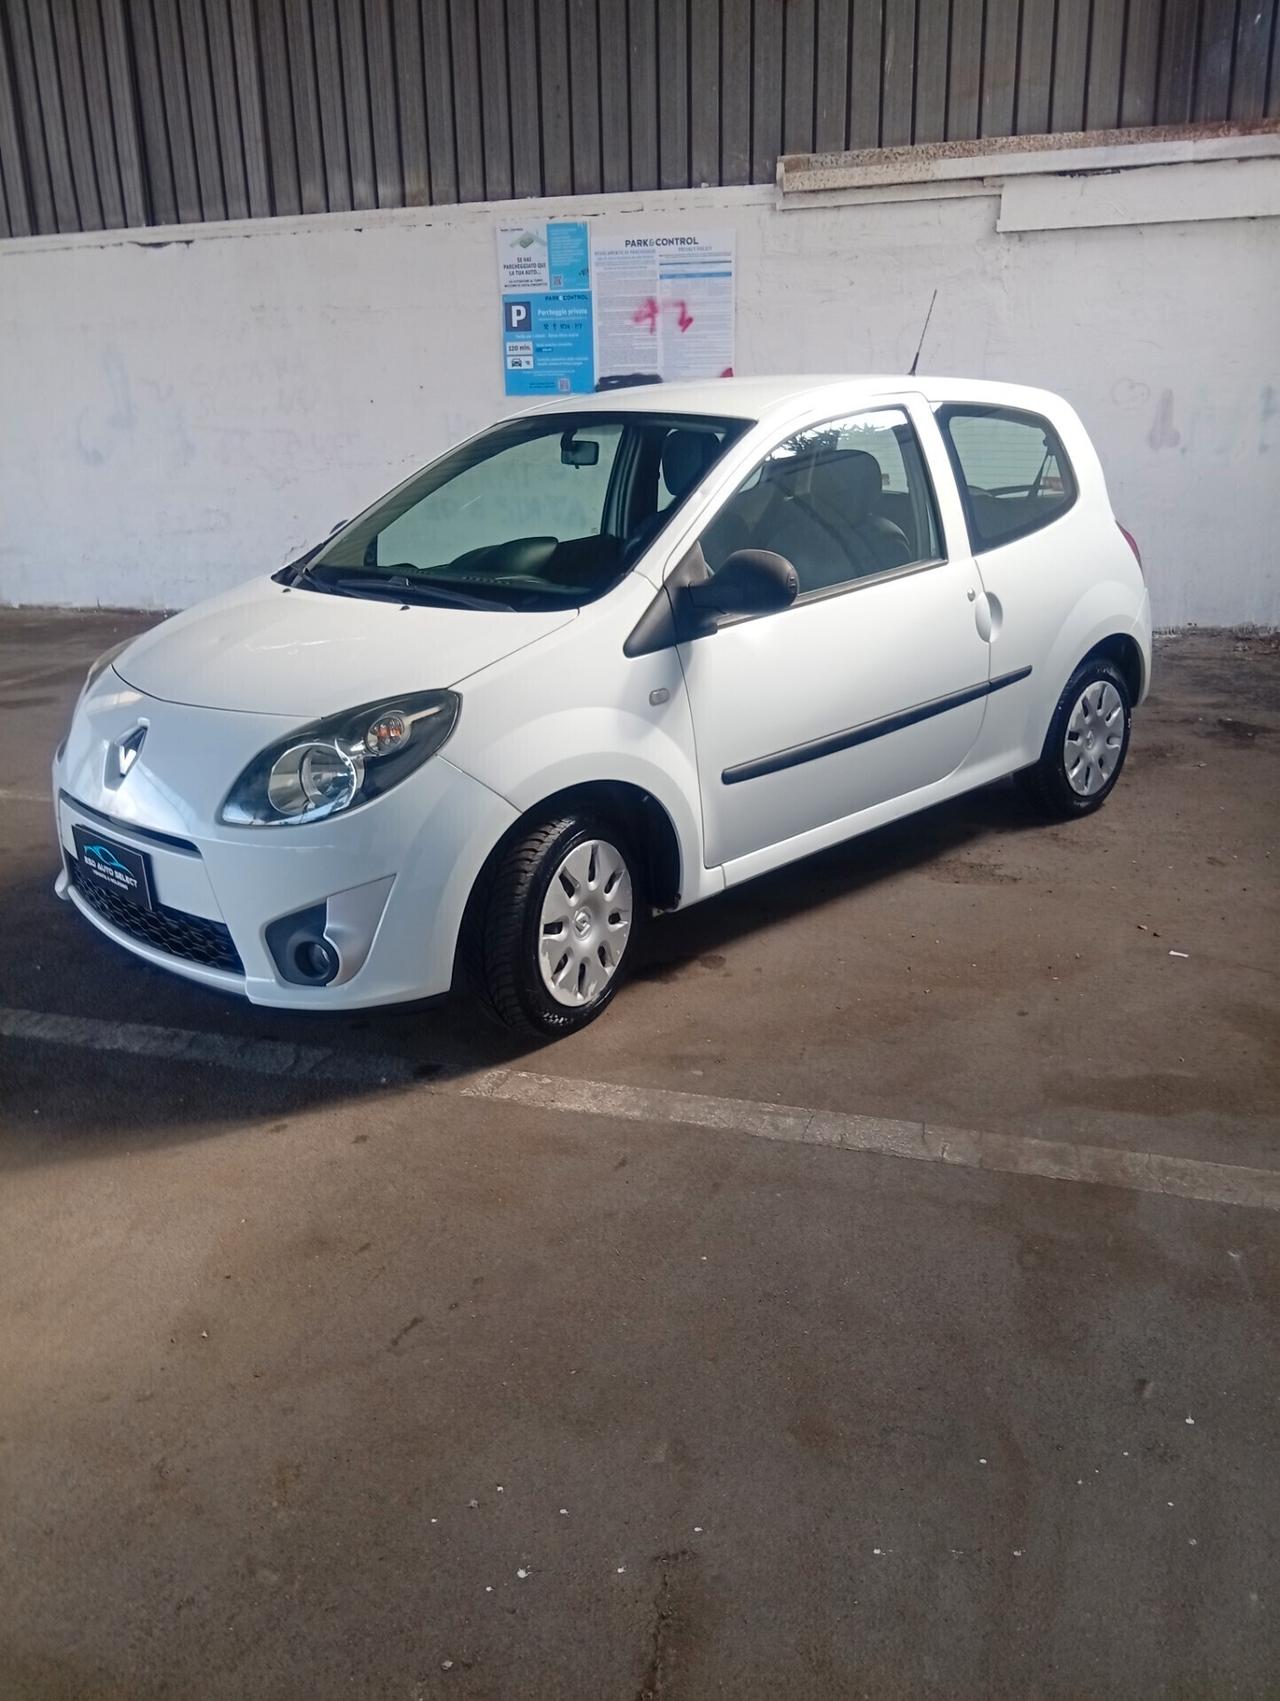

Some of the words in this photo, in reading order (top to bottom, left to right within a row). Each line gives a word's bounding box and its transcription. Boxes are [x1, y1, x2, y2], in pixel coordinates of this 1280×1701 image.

[625, 237, 699, 248] PARK&CONTROL
[511, 305, 527, 327] P
[97, 862, 114, 876] AUTO
